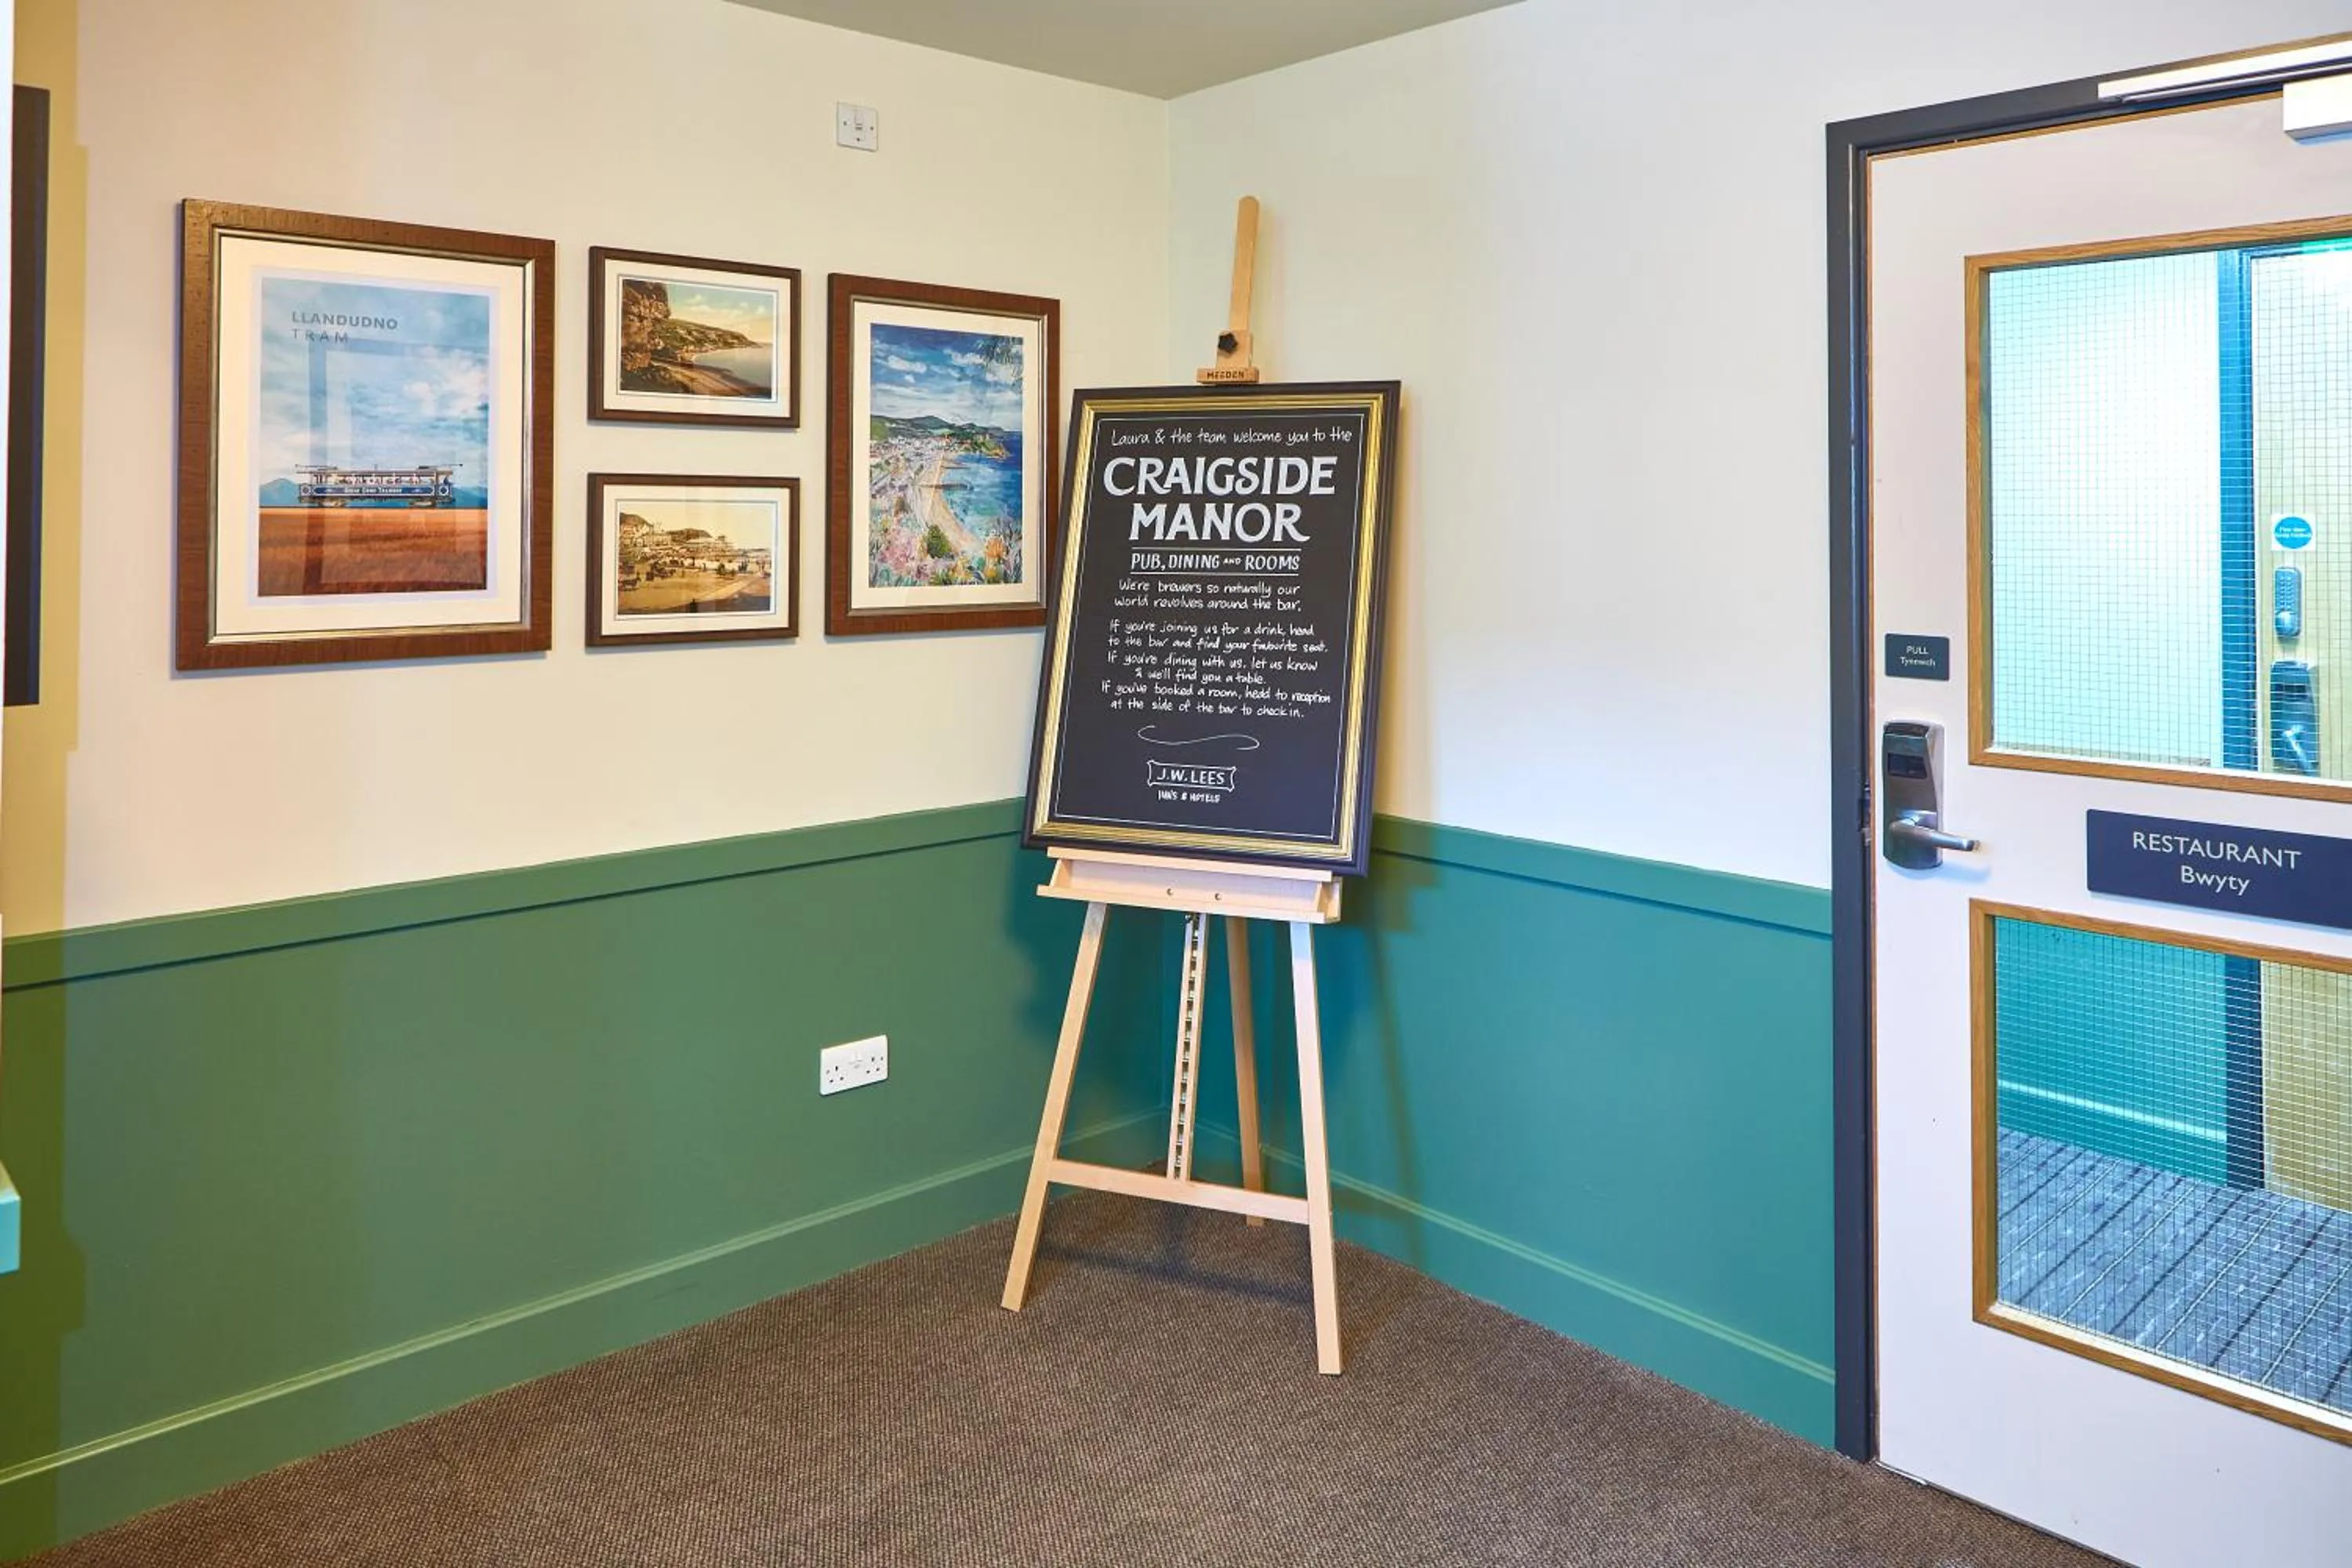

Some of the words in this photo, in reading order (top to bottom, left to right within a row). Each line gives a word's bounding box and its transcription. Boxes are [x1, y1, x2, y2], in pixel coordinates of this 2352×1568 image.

[292, 311, 398, 330] LLANDUDNO
[291, 328, 348, 343] TRAM
[1111, 428, 1150, 446] Laura
[1155, 428, 1166, 445] &
[1170, 427, 1192, 444] the
[1197, 427, 1227, 445] team
[1233, 427, 1283, 443] welcome
[1286, 431, 1309, 446] you
[1312, 426, 1326, 442] to
[1330, 426, 1352, 442] the
[1103, 456, 1338, 496] CRAIGSIDE
[1129, 503, 1311, 543] MANOR
[1131, 553, 1166, 571] PUB,
[1168, 554, 1219, 570] DINING
[1244, 554, 1300, 571] ROOMS
[1158, 580, 1202, 593] brewers
[1207, 584, 1220, 593] so
[1224, 580, 1272, 598] naturally
[1277, 586, 1301, 595] our
[1114, 594, 1149, 607] world
[1153, 595, 1203, 608] revolves
[1207, 597, 1248, 609] around
[1253, 597, 1272, 609] the
[1109, 619, 1120, 633] If
[1160, 620, 1198, 637] joining
[1203, 625, 1218, 634] us
[1221, 622, 1240, 636] for
[1108, 634, 1120, 647] to
[1125, 636, 1142, 647] the
[1149, 633, 1169, 647] bar
[1172, 637, 1192, 648] and
[1196, 637, 1221, 651] find
[1222, 640, 1250, 654] your
[1906, 645, 1929, 655] PULL
[1108, 650, 1117, 663] If
[1163, 652, 1197, 669] dining
[1202, 655, 1225, 666] with
[1250, 655, 1268, 670] let
[1269, 661, 1283, 670] us
[1287, 656, 1319, 670] know
[1175, 667, 1197, 682] find
[1200, 673, 1221, 684] you
[1102, 680, 1111, 693] If
[1154, 681, 1193, 695] booked
[1275, 688, 1288, 701] to
[1292, 689, 1331, 706] reception
[1110, 697, 1122, 709] at
[1128, 697, 1144, 710] the
[1152, 696, 1173, 711] side
[1178, 699, 1191, 713] of
[1196, 701, 1214, 713] the
[1219, 702, 1238, 714] bar
[1241, 703, 1253, 715] to
[1191, 770, 1225, 785] LEES
[1189, 793, 1221, 803] HOTELS
[2132, 831, 2302, 869] RESTAURANT
[2181, 865, 2250, 896] Bwyty
